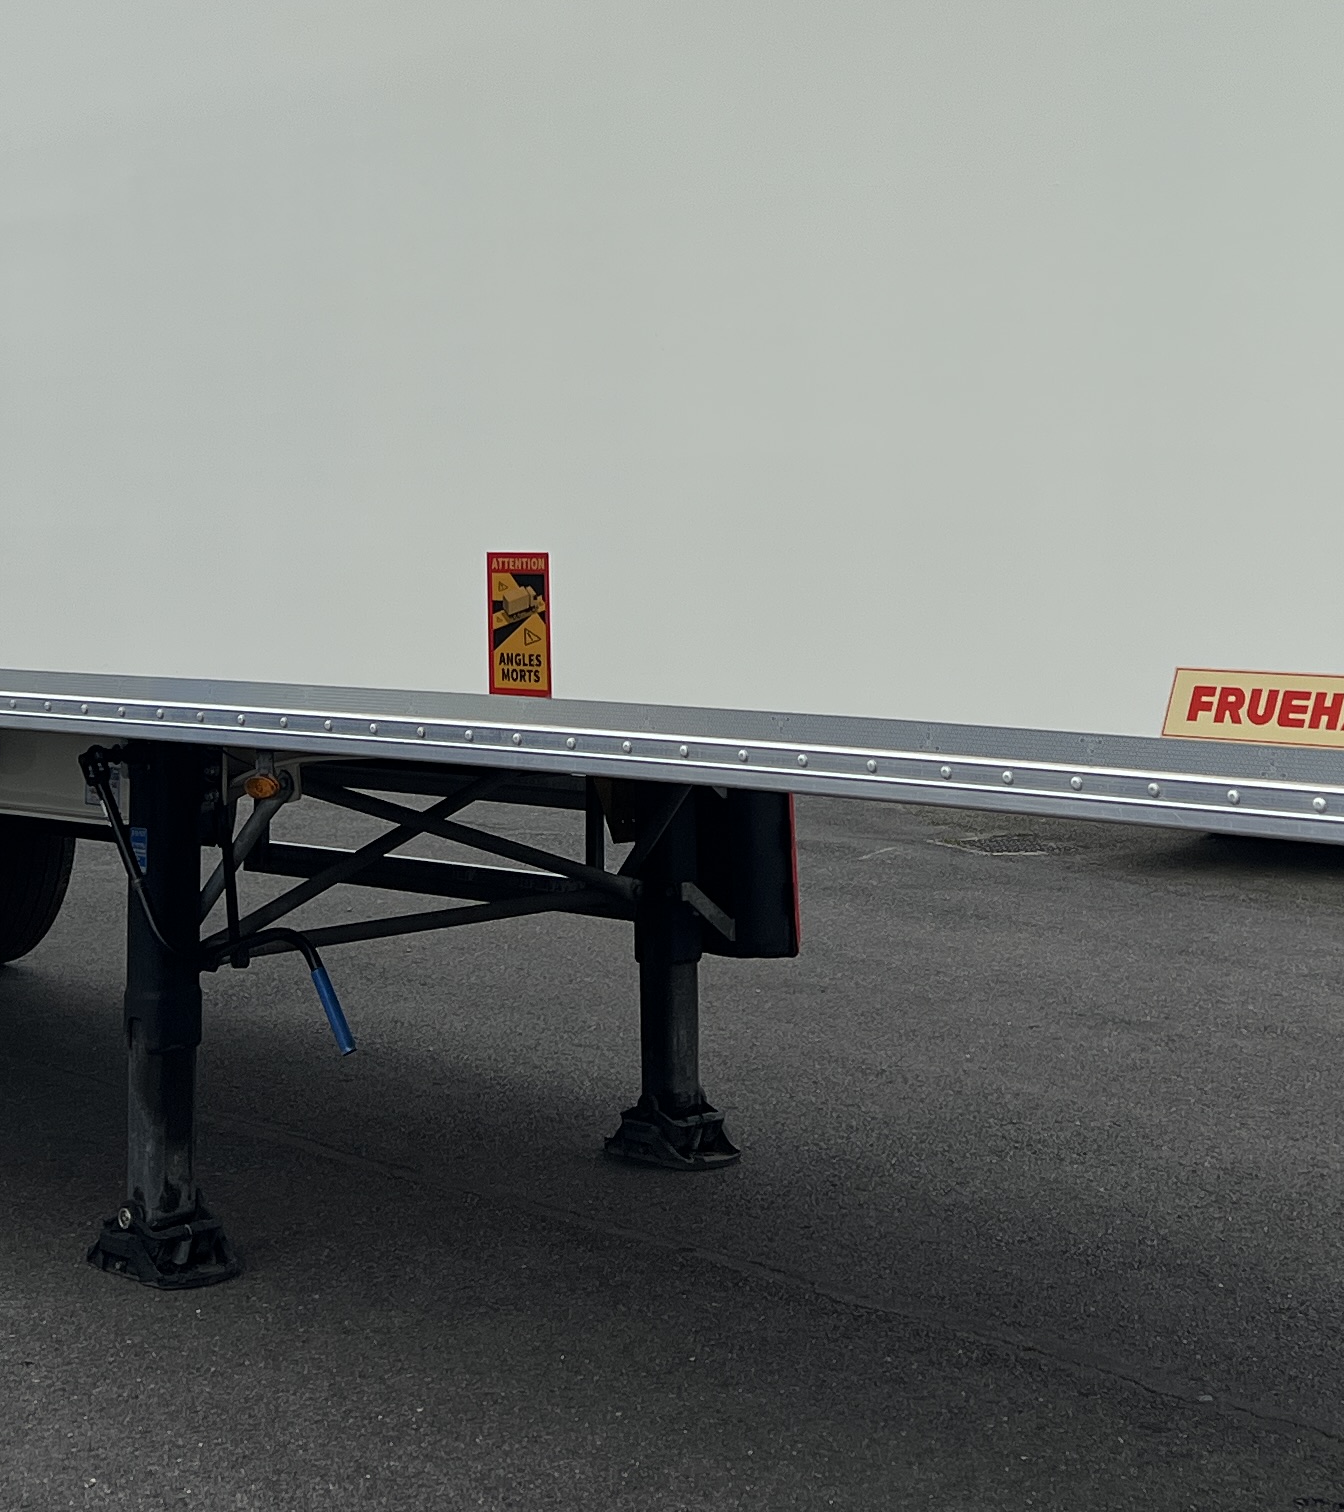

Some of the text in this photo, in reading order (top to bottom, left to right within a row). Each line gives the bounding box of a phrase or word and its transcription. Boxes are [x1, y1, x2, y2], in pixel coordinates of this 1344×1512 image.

[491, 557, 546, 571] ATTENTION
[498, 652, 542, 668] ANGLES
[501, 668, 541, 683] MORTS
